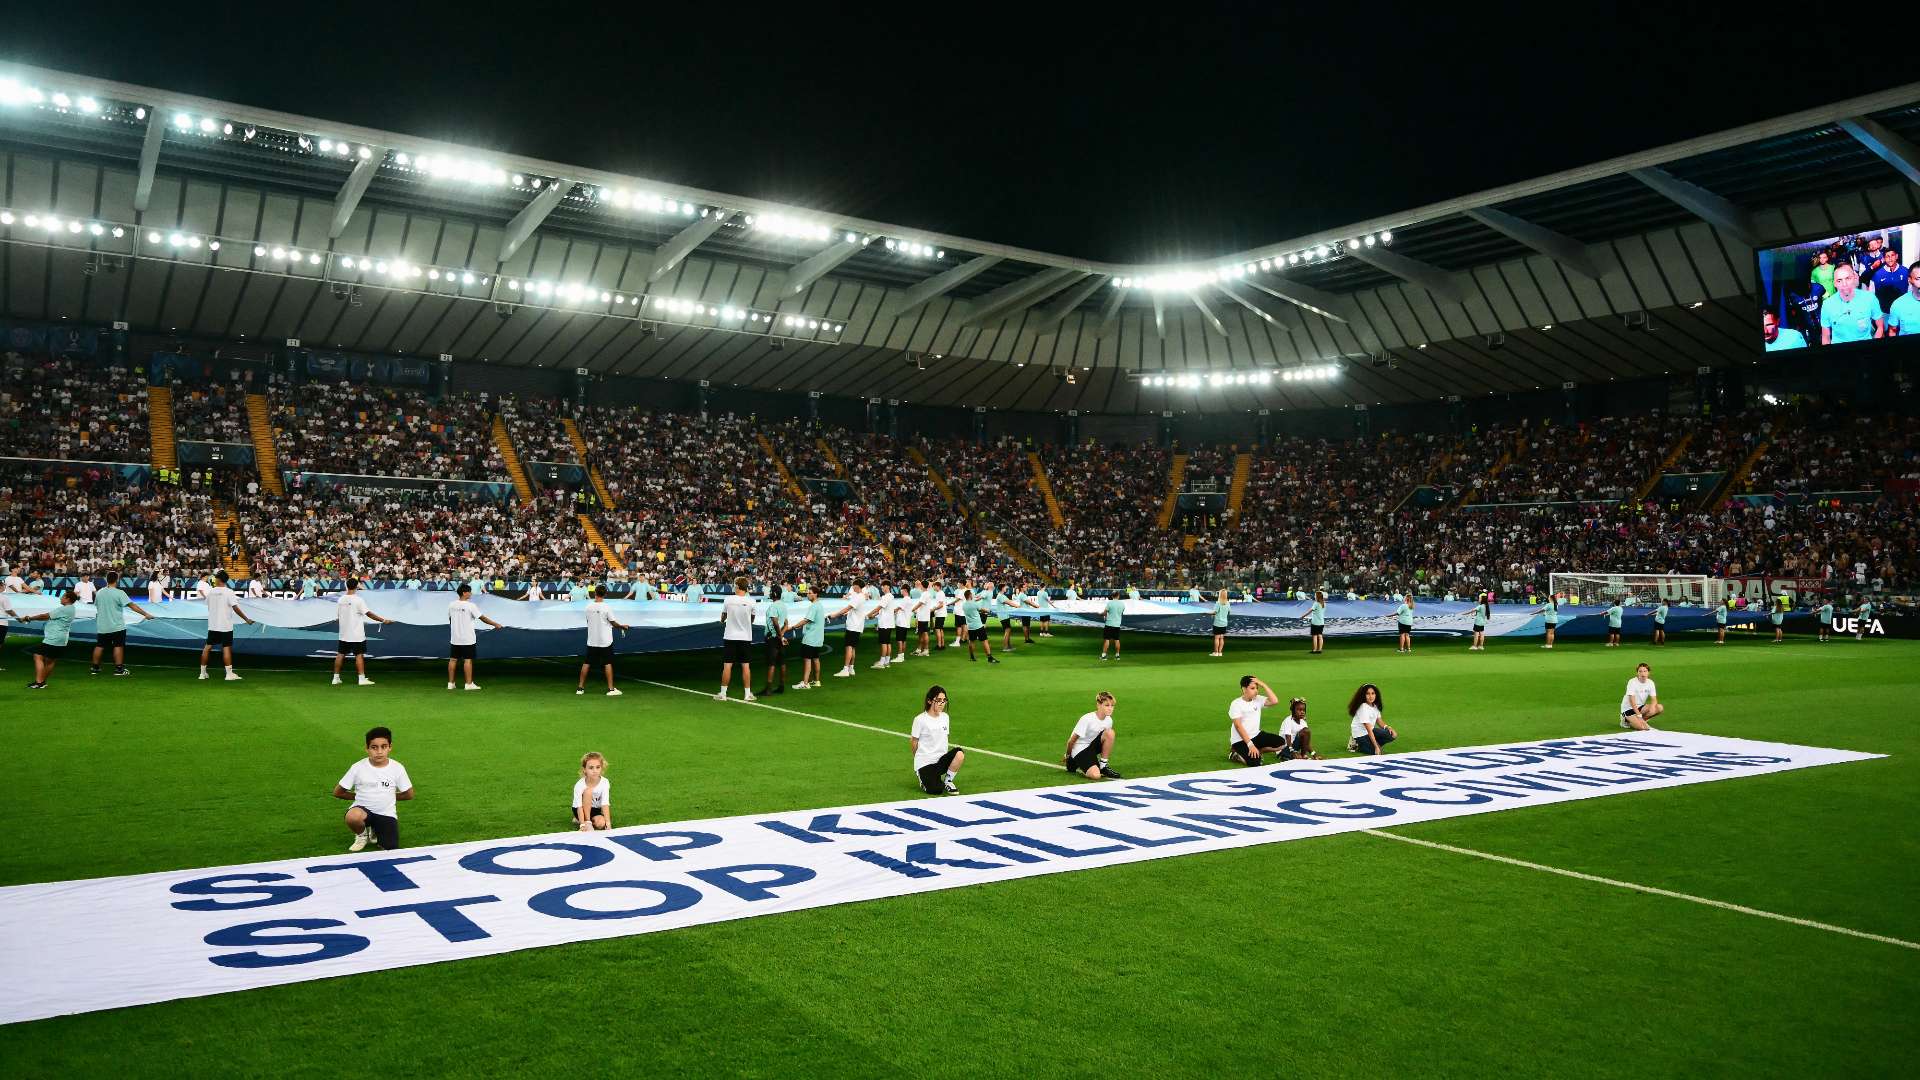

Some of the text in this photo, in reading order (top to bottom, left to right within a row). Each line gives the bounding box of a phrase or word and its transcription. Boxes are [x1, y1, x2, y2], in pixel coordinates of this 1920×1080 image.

[170, 738, 1682, 912] STOP KILLING CHILDREN
[204, 863, 817, 968] STOP
[842, 798, 1397, 879] KILLING
